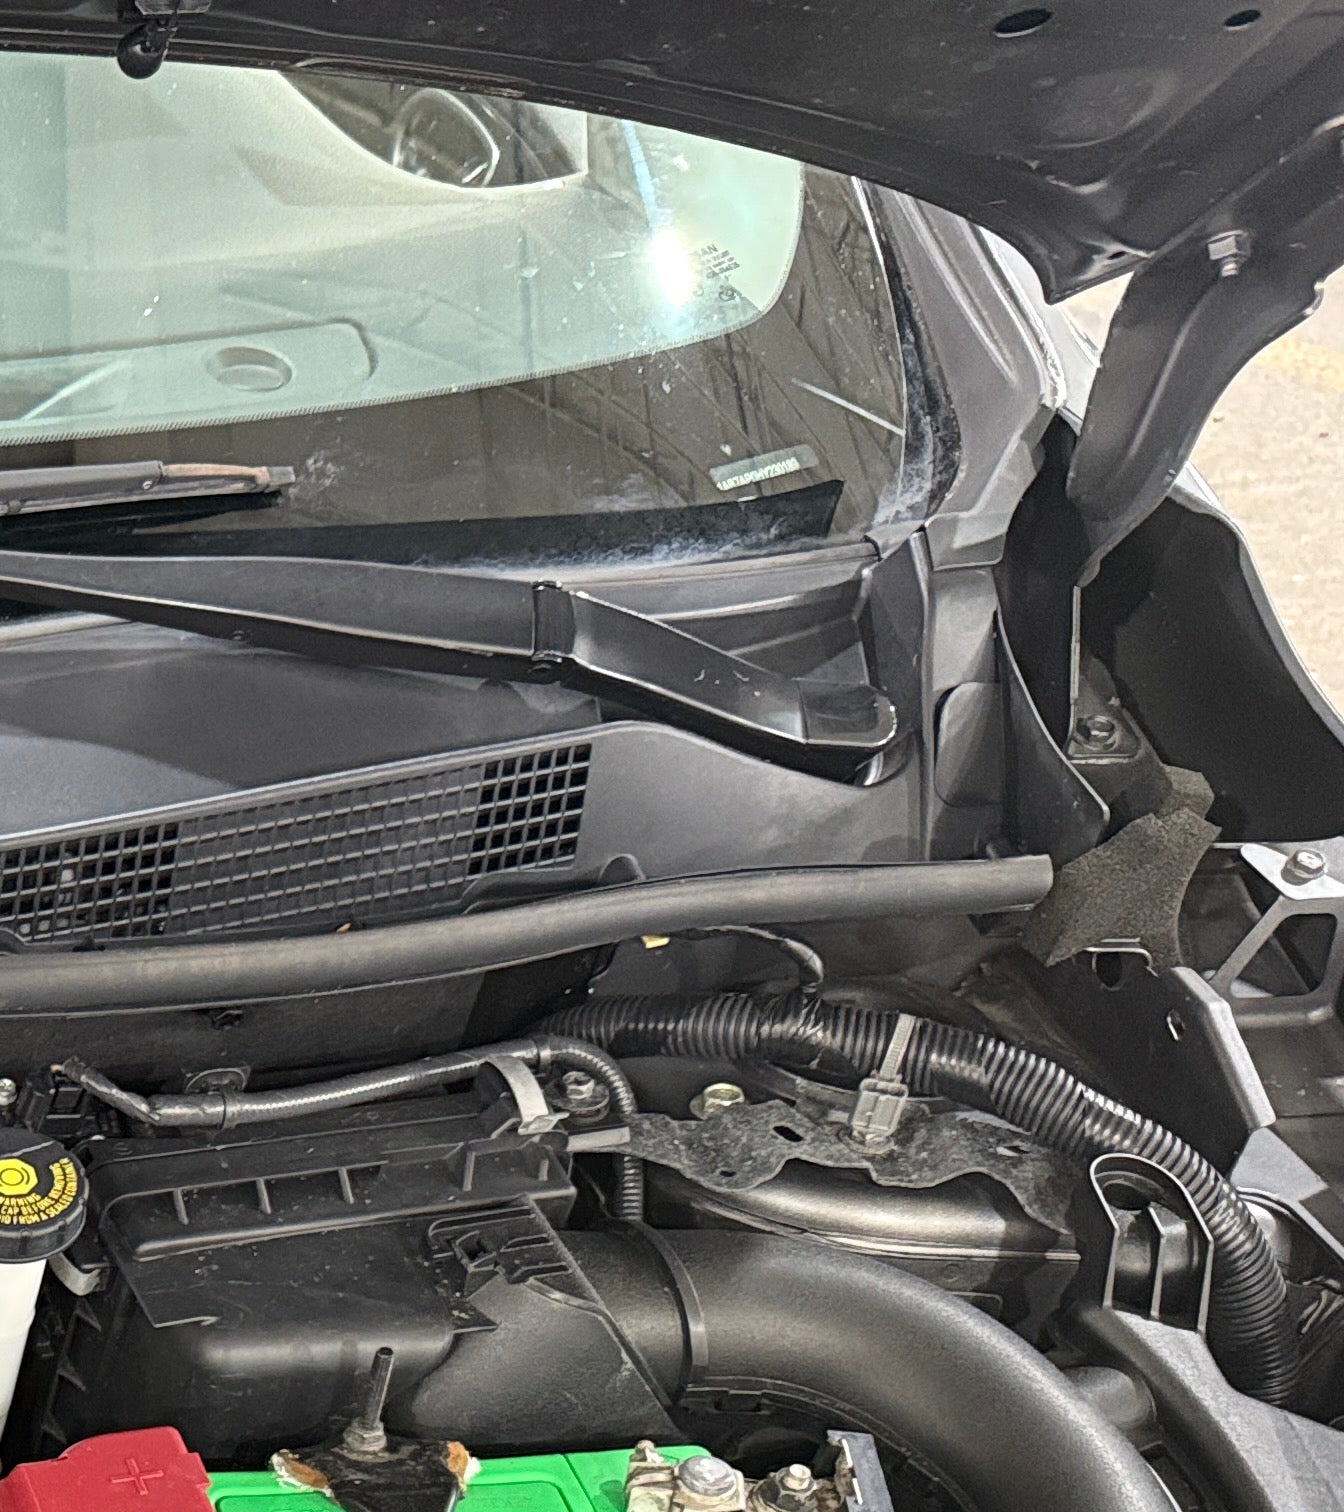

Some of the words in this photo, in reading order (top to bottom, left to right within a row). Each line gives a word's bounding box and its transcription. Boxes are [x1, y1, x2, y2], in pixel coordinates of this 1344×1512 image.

[1, 1205, 19, 1215] CAP
[20, 1196, 56, 1213] BEFORE
[48, 1162, 65, 1199] REMOVING
[45, 1194, 74, 1218] SEALED
